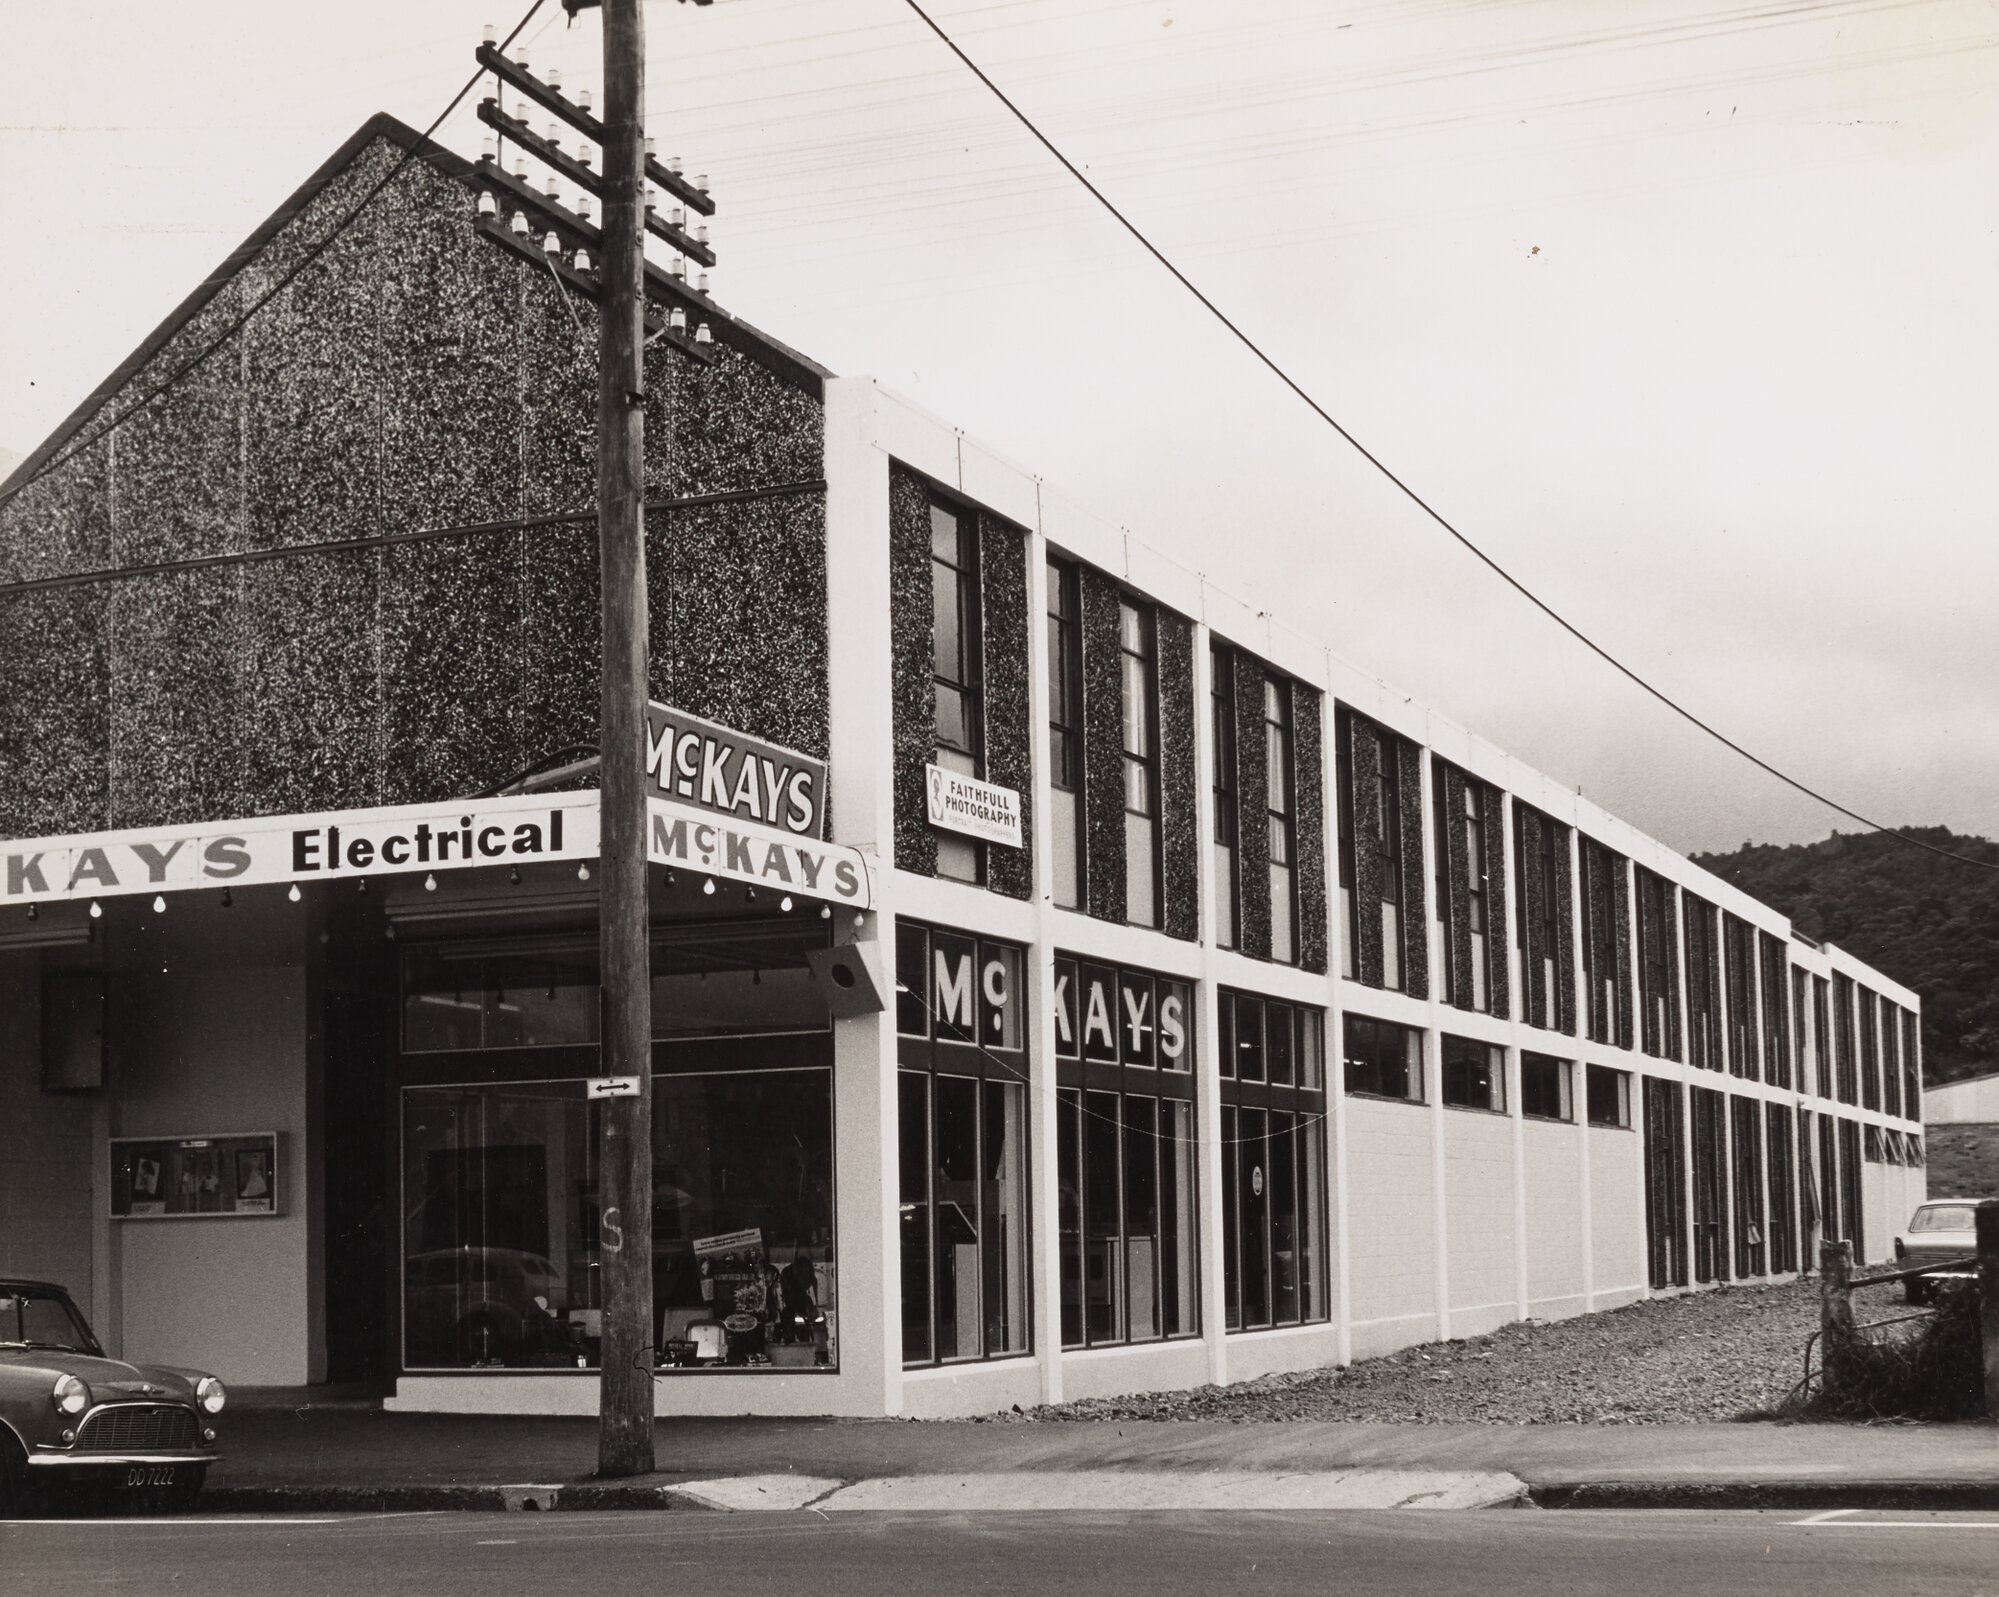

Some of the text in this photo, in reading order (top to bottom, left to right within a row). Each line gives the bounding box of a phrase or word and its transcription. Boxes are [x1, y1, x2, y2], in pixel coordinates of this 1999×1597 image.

[945, 795, 1017, 828] PHOTOGRAPHY
[950, 780, 1010, 811] FAITHFULL
[6, 809, 563, 895] KAYS Electrical
